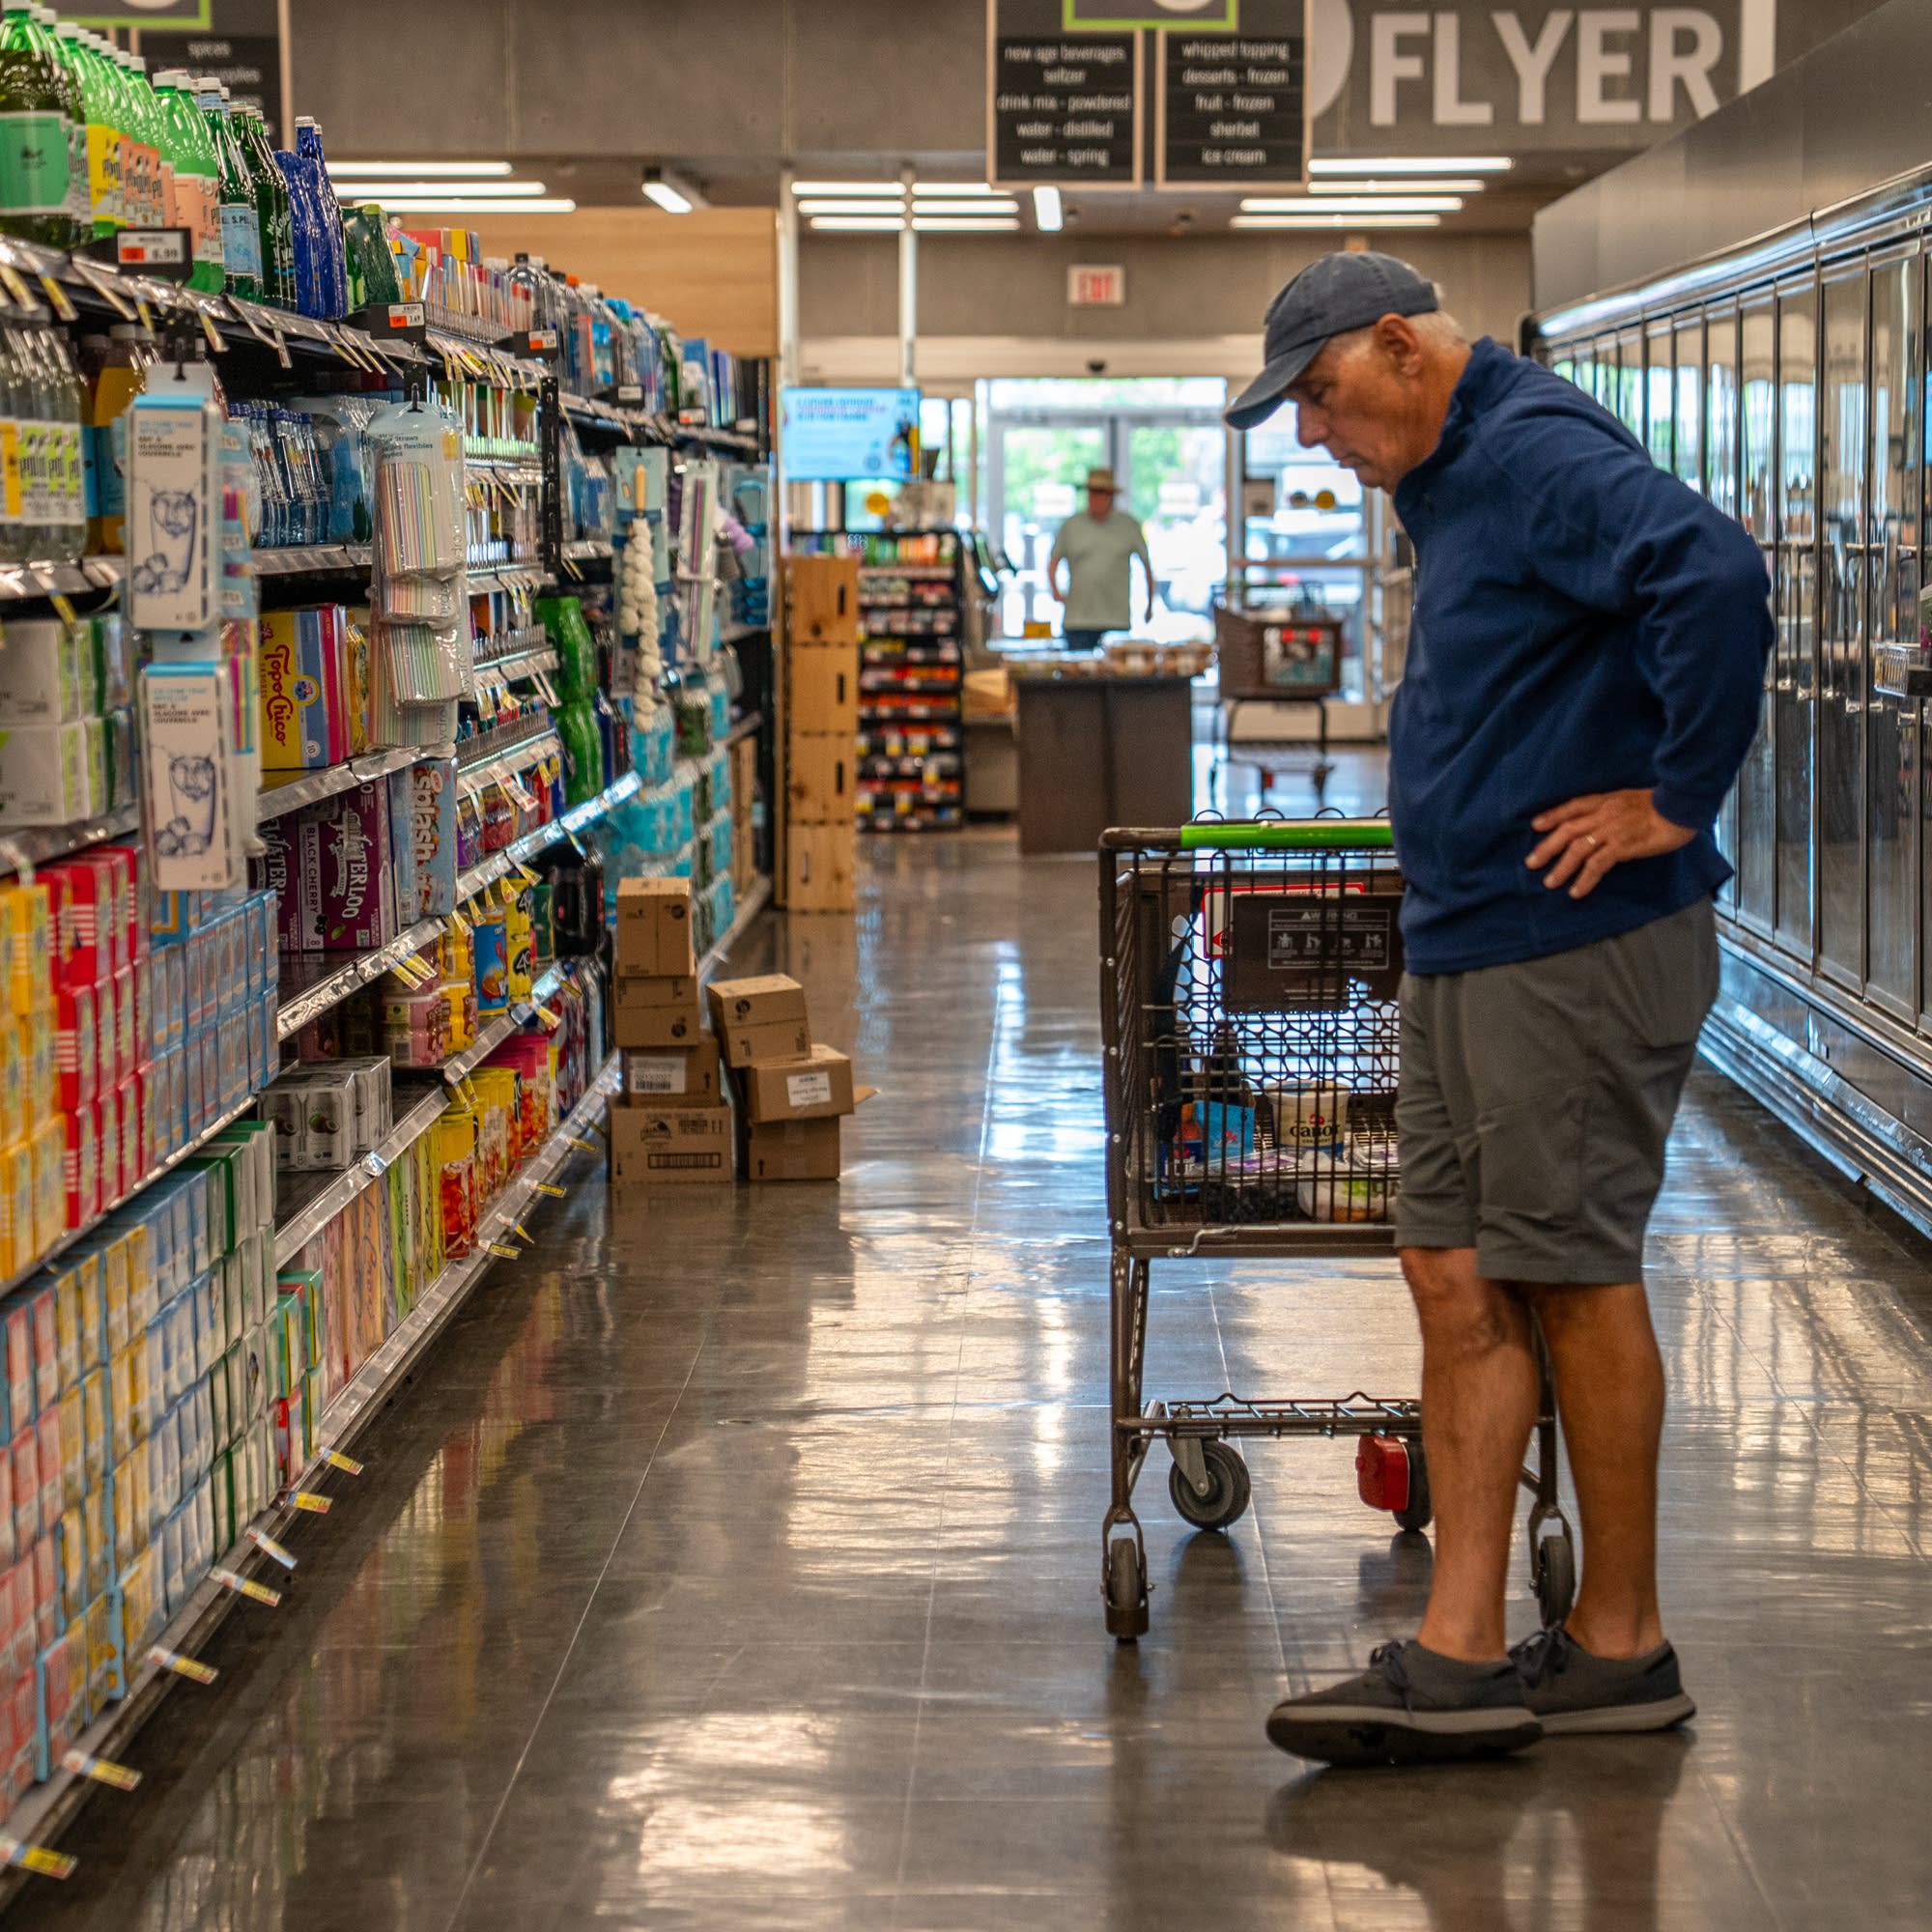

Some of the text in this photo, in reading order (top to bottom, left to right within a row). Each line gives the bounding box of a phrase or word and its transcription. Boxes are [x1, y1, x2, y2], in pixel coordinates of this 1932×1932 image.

[1005, 43, 1126, 65] new age beverages
[1181, 42, 1290, 62] whipped topping
[1043, 67, 1086, 83] seltzer
[1181, 68, 1236, 85] desserts
[1247, 67, 1290, 85] frozen
[1370, 8, 1722, 127] FLYER
[997, 94, 1031, 110] drink
[1033, 95, 1058, 110] mix
[1067, 94, 1131, 113] powdered
[1195, 94, 1223, 112] fruit
[1233, 93, 1274, 112] frozen
[1016, 121, 1053, 137] water
[1063, 119, 1114, 137] distilled
[1209, 121, 1260, 138] sherbet
[1020, 148, 1057, 164] water
[1066, 148, 1110, 168] spring
[1202, 147, 1265, 165] ice cream
[264, 643, 291, 696] Topo
[266, 693, 294, 747] Chico
[306, 744, 316, 754] 10
[413, 774, 438, 862] splash
[306, 827, 320, 914] BLACK CHERRY
[1312, 911, 1358, 921] WRNNG
